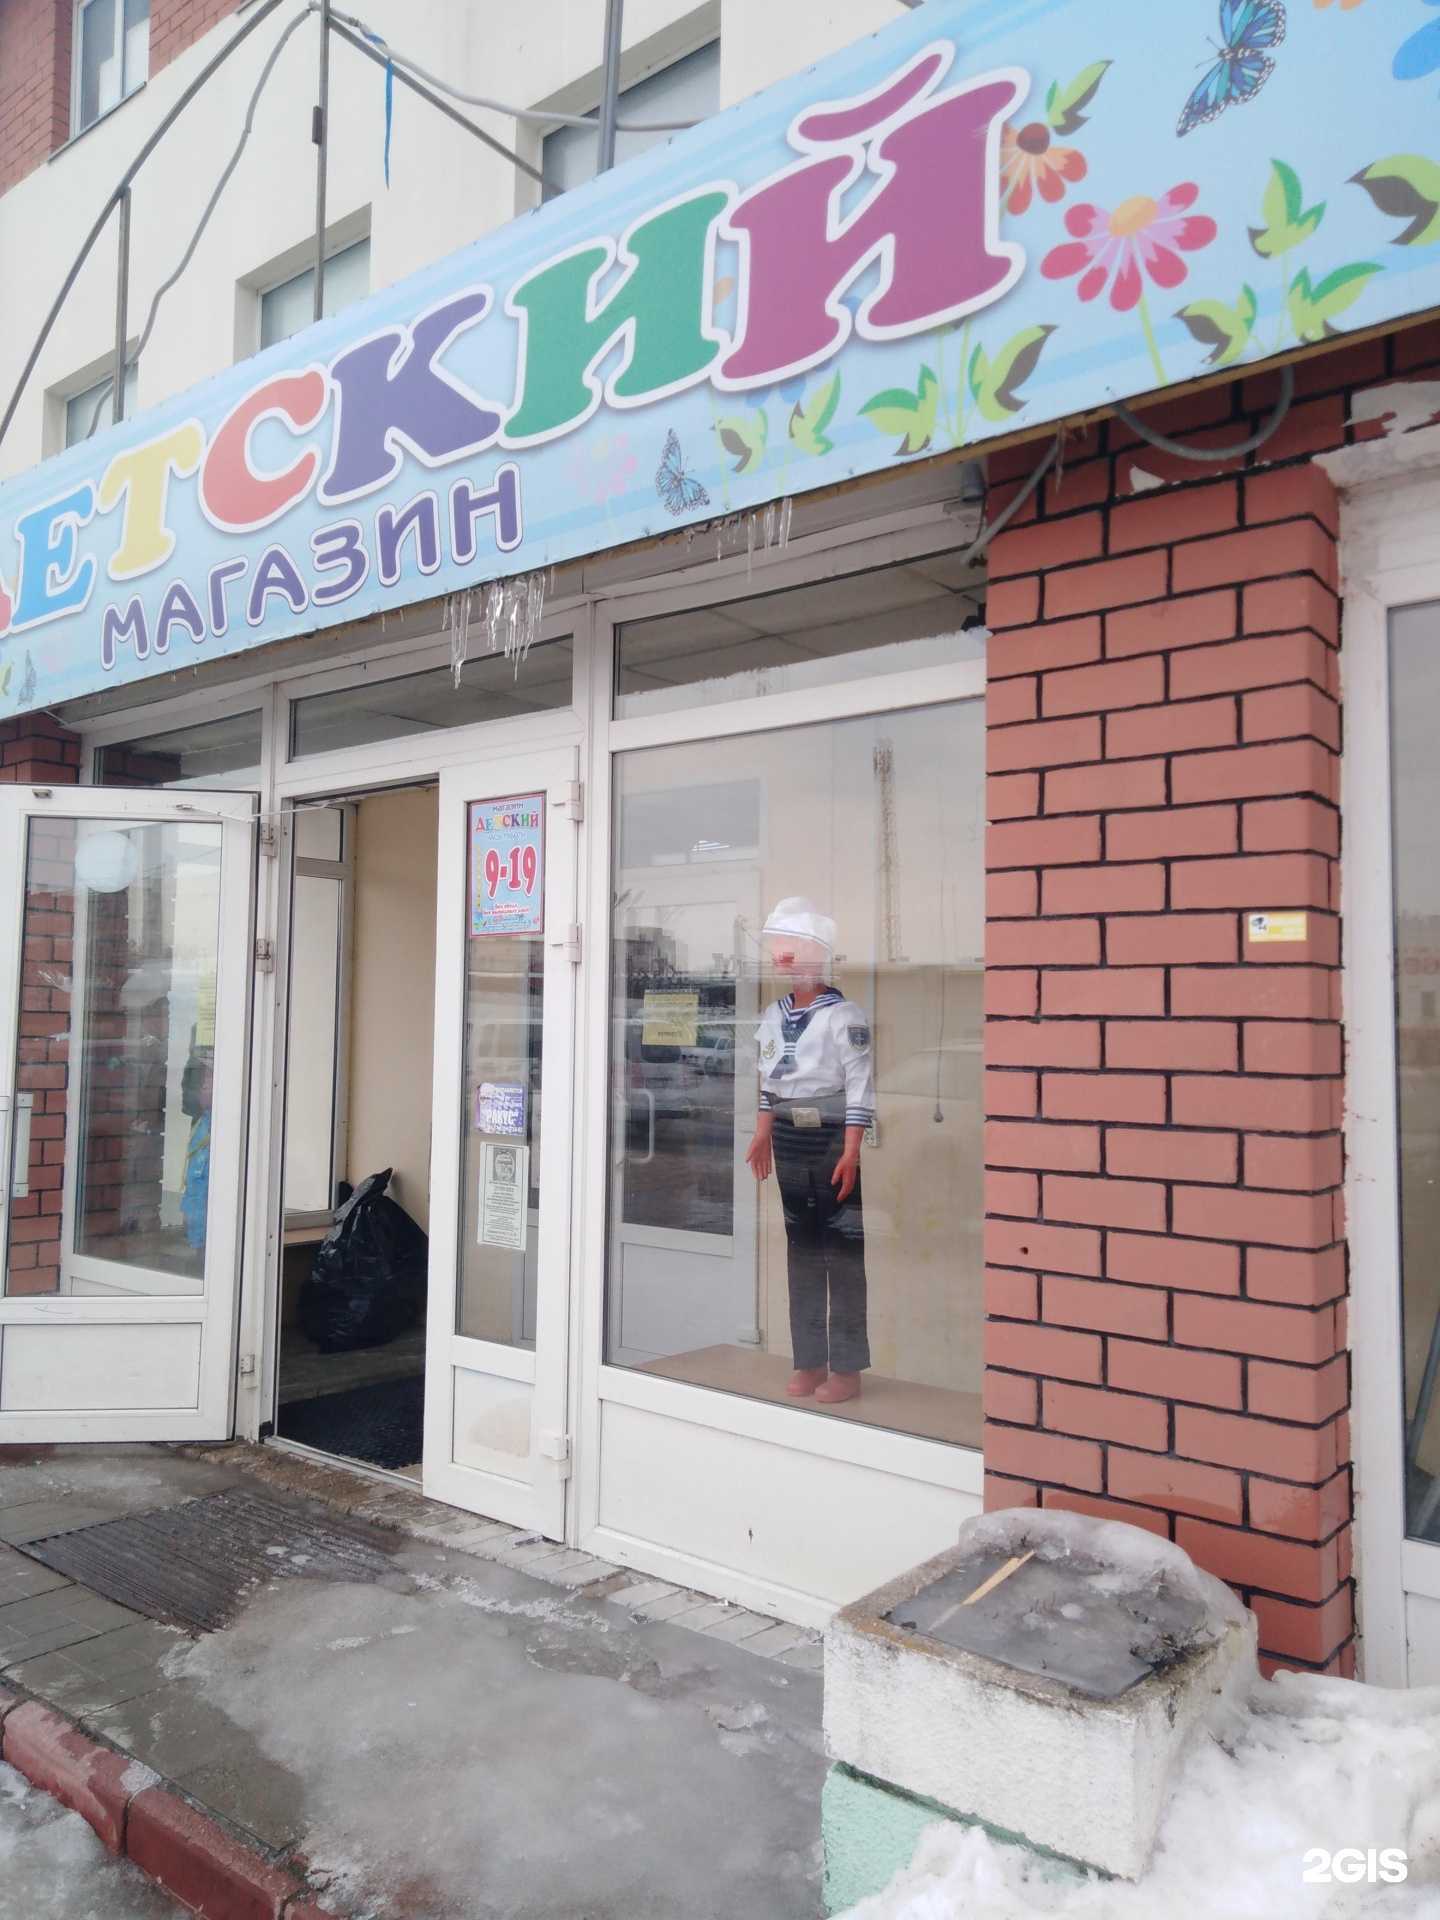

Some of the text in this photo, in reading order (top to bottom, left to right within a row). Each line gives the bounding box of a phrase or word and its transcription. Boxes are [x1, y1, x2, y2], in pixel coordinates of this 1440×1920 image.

[0, 39, 1031, 636] ЕТСКИЙ
[101, 462, 522, 671] МАГАЗИН
[485, 845, 537, 898] 9-19
